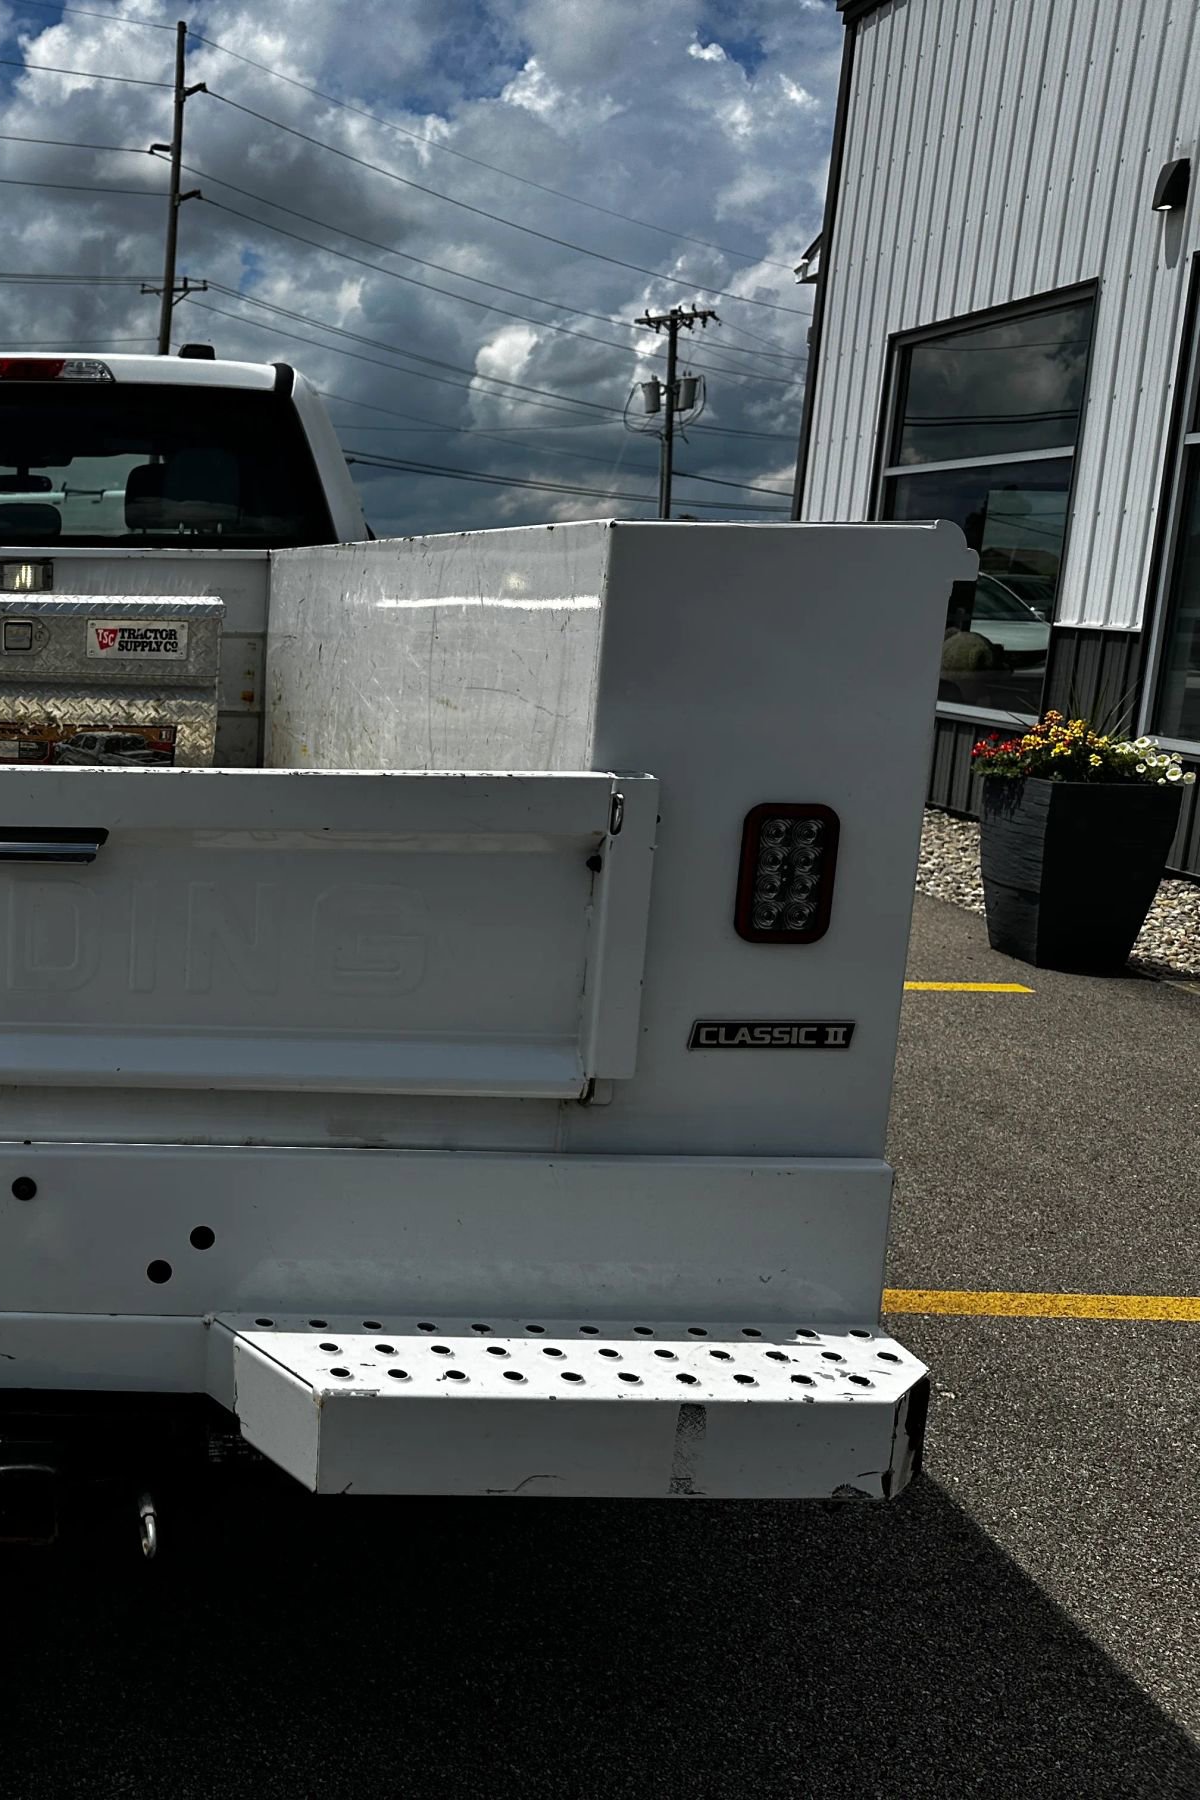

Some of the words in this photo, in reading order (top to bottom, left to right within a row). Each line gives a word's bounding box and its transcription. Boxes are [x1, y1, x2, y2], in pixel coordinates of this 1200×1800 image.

[98, 629, 115, 646] TSC
[119, 628, 177, 640] TRACTOR
[118, 641, 162, 652] SUPPLY
[700, 1027, 818, 1045] CLASSIC
[824, 1027, 847, 1045] II
